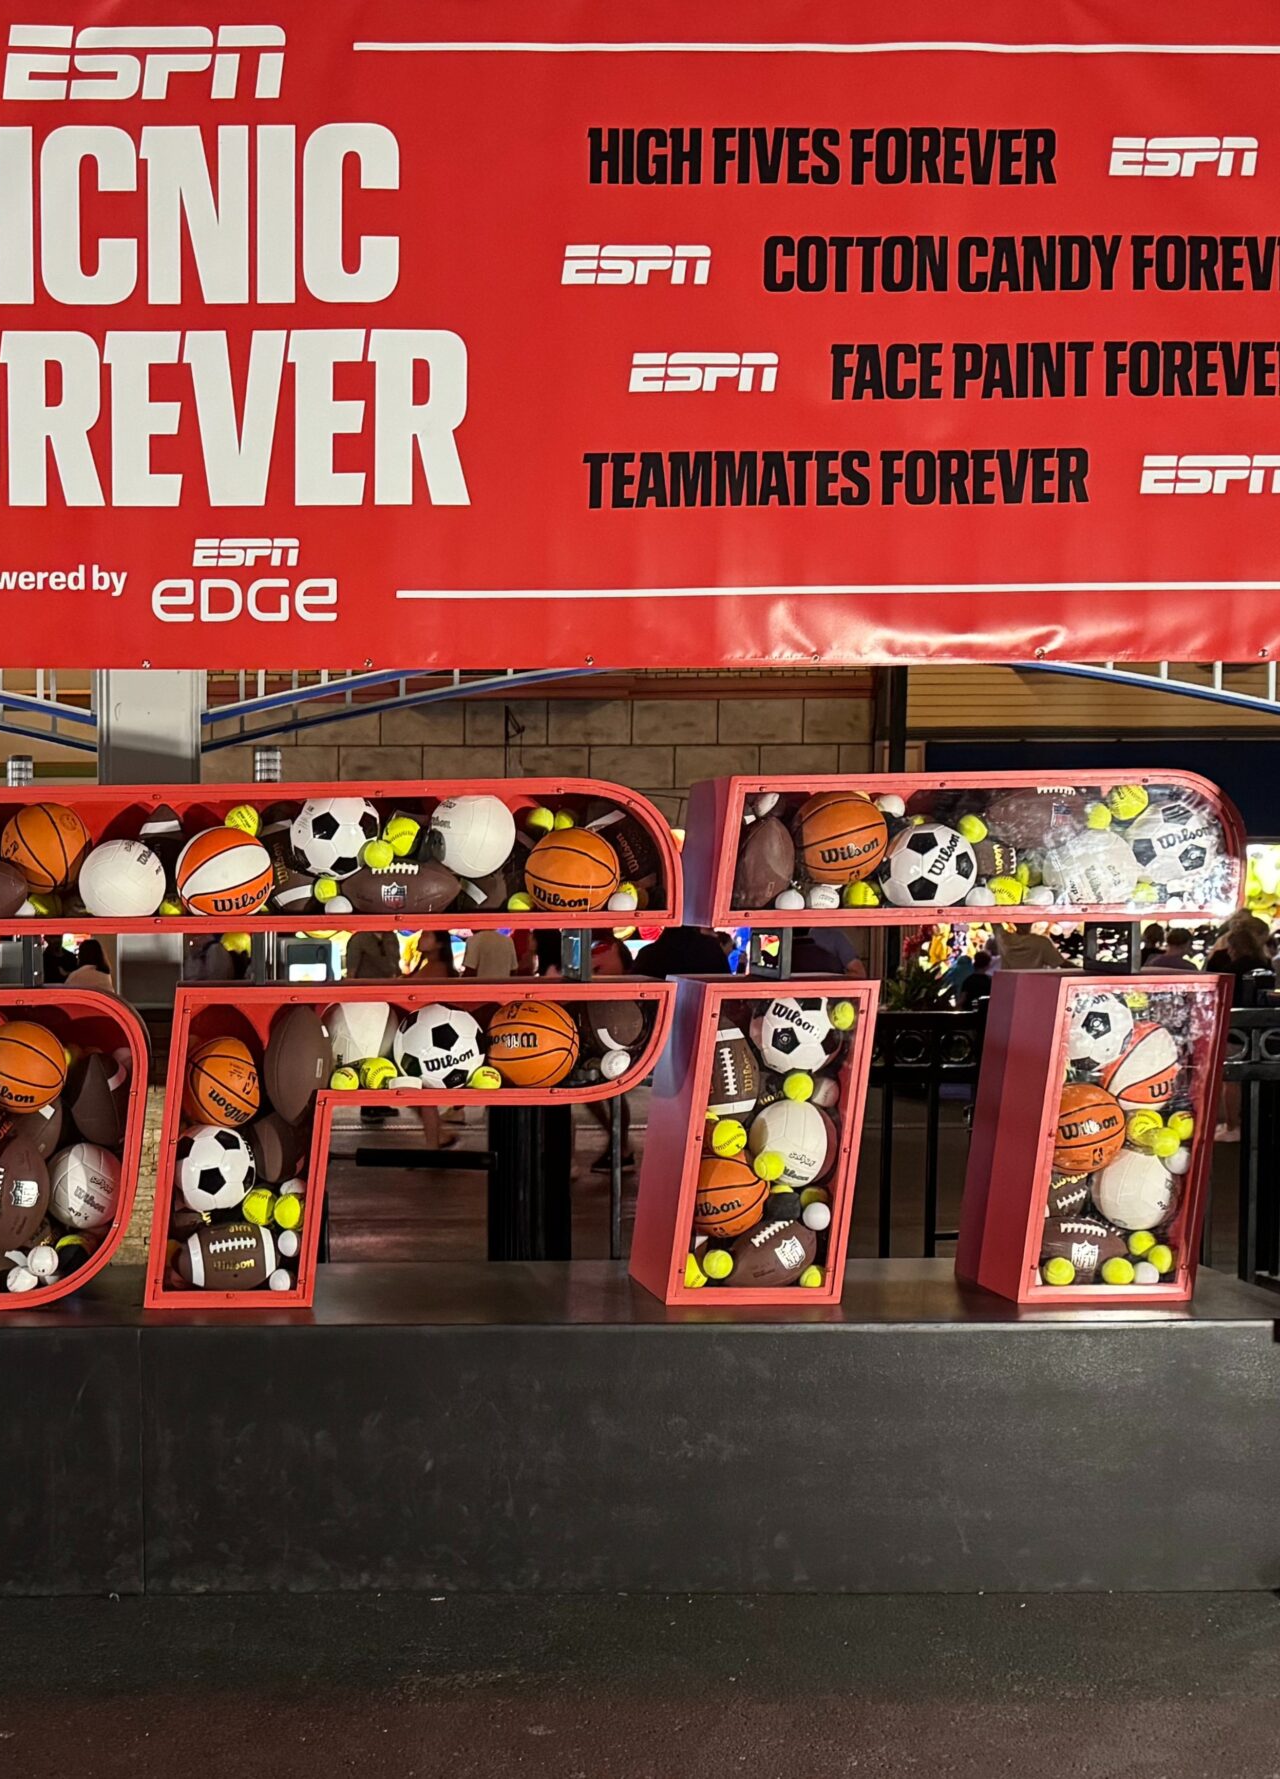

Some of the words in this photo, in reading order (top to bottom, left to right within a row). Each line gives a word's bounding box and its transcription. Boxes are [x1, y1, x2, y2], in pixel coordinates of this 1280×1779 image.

[2, 24, 286, 101] ESPN
[587, 127, 703, 185] HIGH
[712, 127, 840, 185] FIVES
[849, 127, 1057, 186] FOREVER
[1108, 136, 1259, 177] ESPN
[561, 244, 712, 285] ESPN
[763, 235, 949, 293] COTTON
[957, 234, 1122, 293] CANDY
[1130, 235, 1280, 291] FOREV
[628, 352, 779, 393] ESPN
[830, 342, 943, 401] FACE
[952, 341, 1094, 399] PAINT
[1103, 341, 1280, 397] FOREVE
[582, 450, 871, 509] TEAMMATES
[879, 447, 1089, 506] FOREVER
[1139, 454, 1280, 494] ESPN
[192, 537, 300, 567] ESPN
[92, 564, 128, 597] by
[820, 836, 880, 864] Wilson
[927, 832, 960, 877] Wilson
[1157, 825, 1209, 850] Wilson
[212, 882, 272, 914] Wilson
[532, 883, 589, 908] Wilson
[423, 1048, 474, 1072] Wilson
[208, 1085, 251, 1123] Wilson
[696, 1198, 742, 1217] ilson
